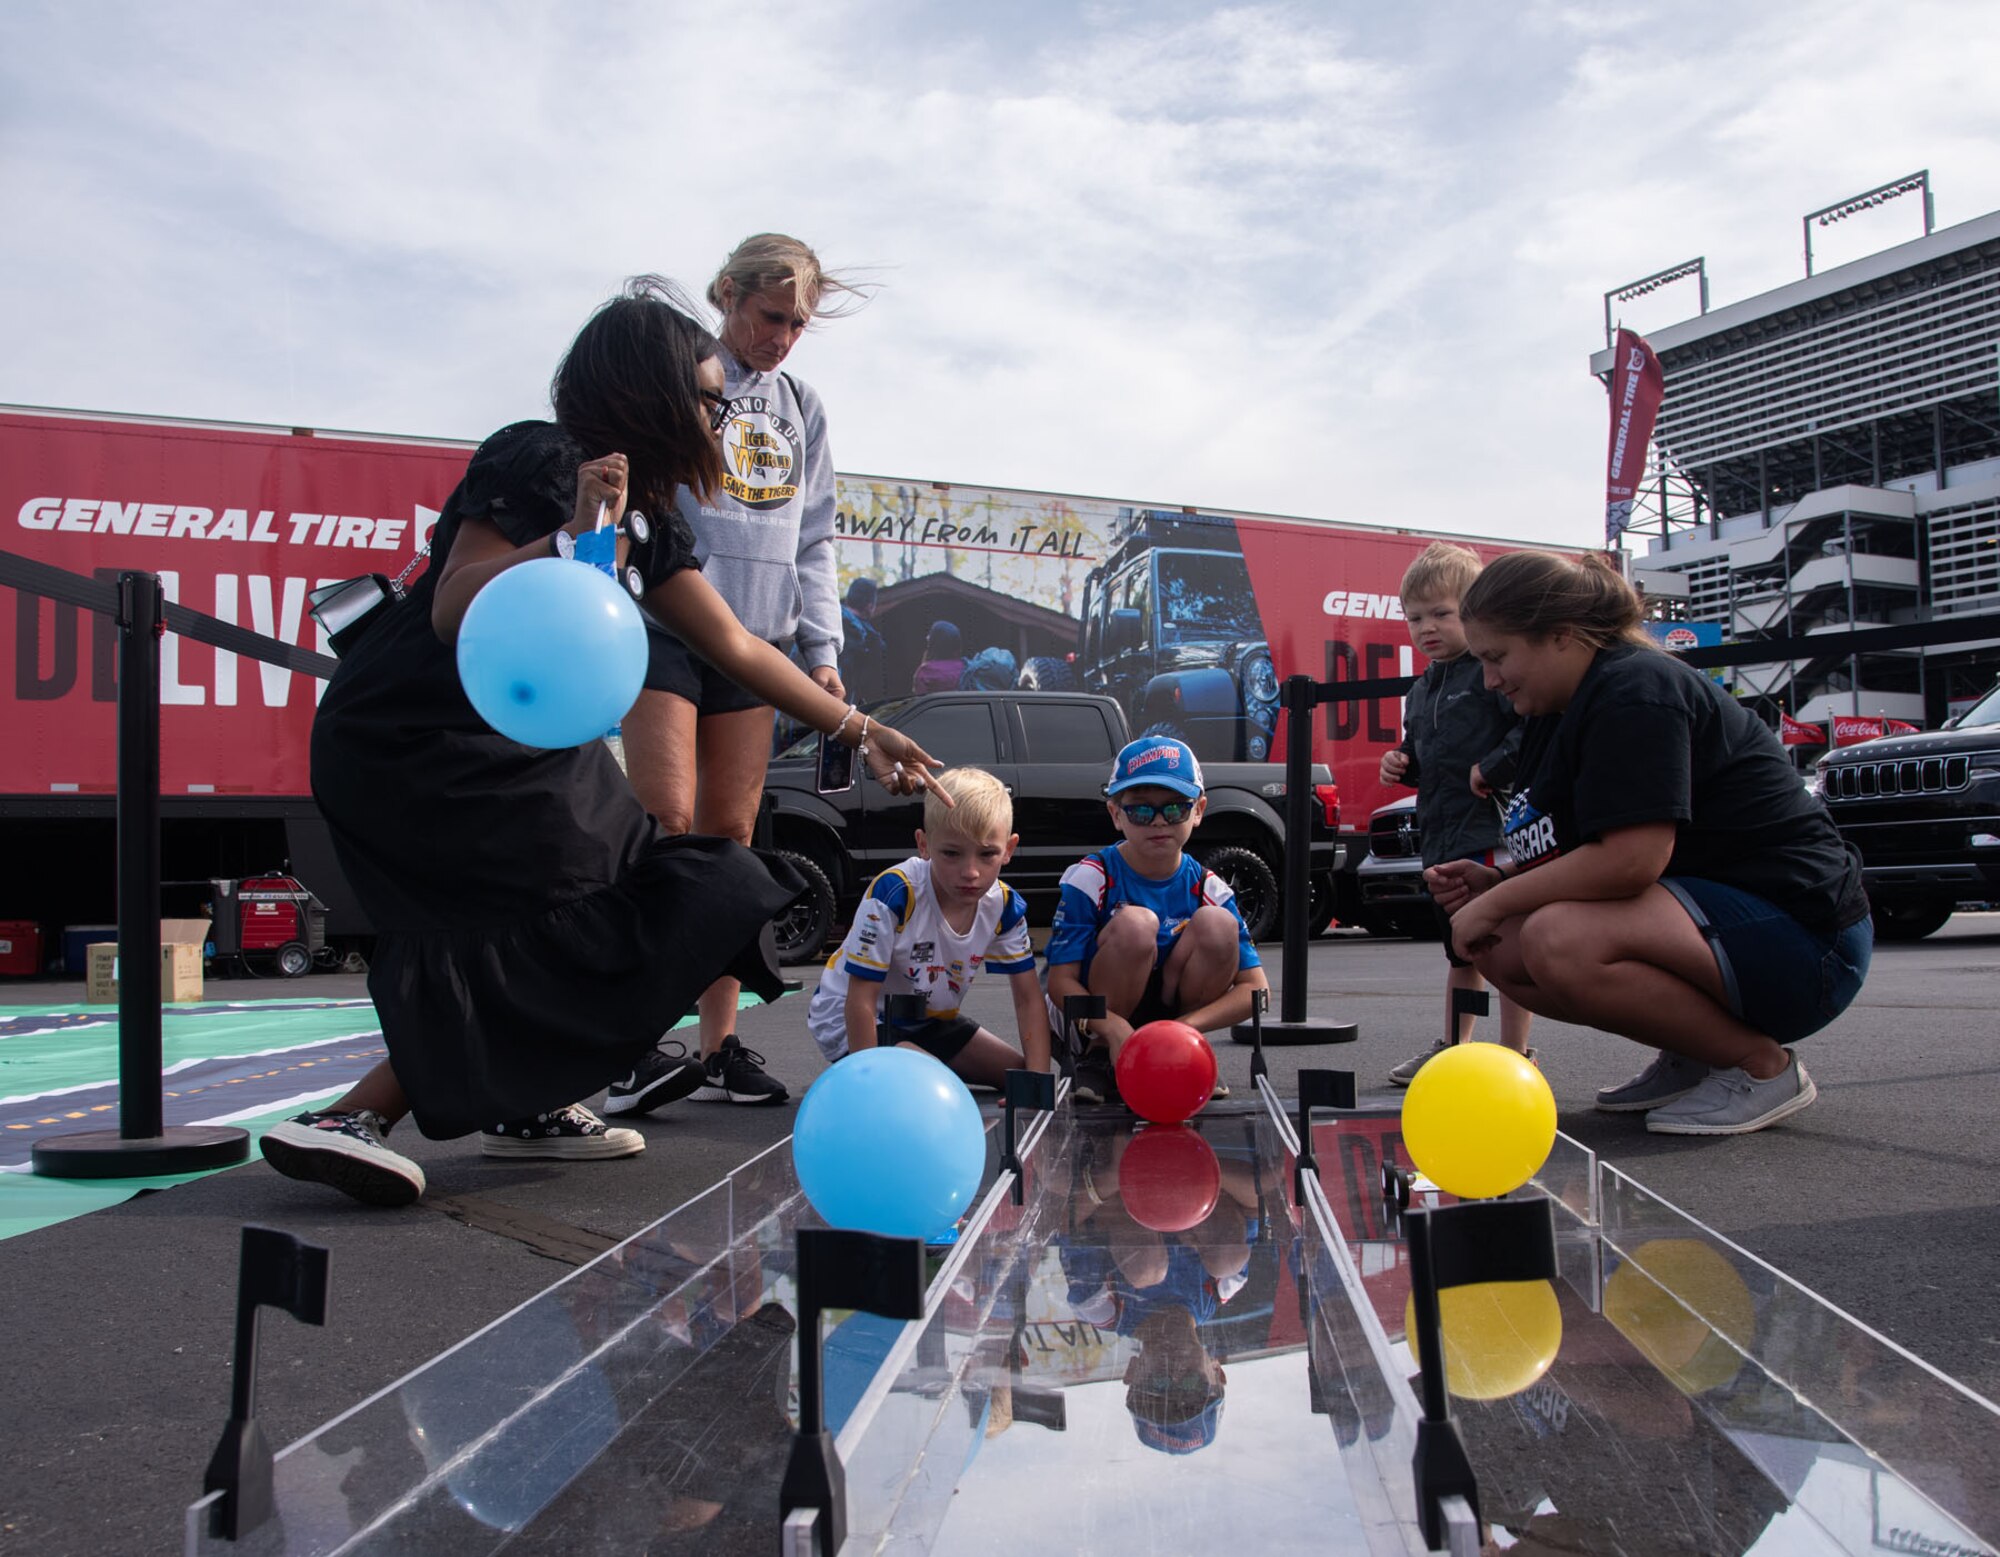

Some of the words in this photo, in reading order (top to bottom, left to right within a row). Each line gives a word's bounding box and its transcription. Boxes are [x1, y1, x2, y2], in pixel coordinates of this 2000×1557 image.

[730, 418, 780, 452] TIGER
[1611, 410, 1632, 480] GENERAL
[1624, 373, 1640, 409] TIRE
[729, 442, 792, 480] WORLD
[724, 476, 746, 498] SAVE
[748, 487, 766, 501] THE
[768, 485, 796, 498] TIGERS
[17, 497, 281, 544] GENERAL
[287, 513, 408, 551] TIRE
[834, 511, 916, 544] AWAY
[922, 517, 998, 544] FROM
[1010, 525, 1038, 554] IT
[1037, 530, 1085, 558] ALL
[1322, 590, 1408, 621] GENE
[1835, 721, 1881, 738] Coca-Cola
[1127, 747, 1180, 776] CHAMPION
[1506, 815, 1558, 866] ASCAR
